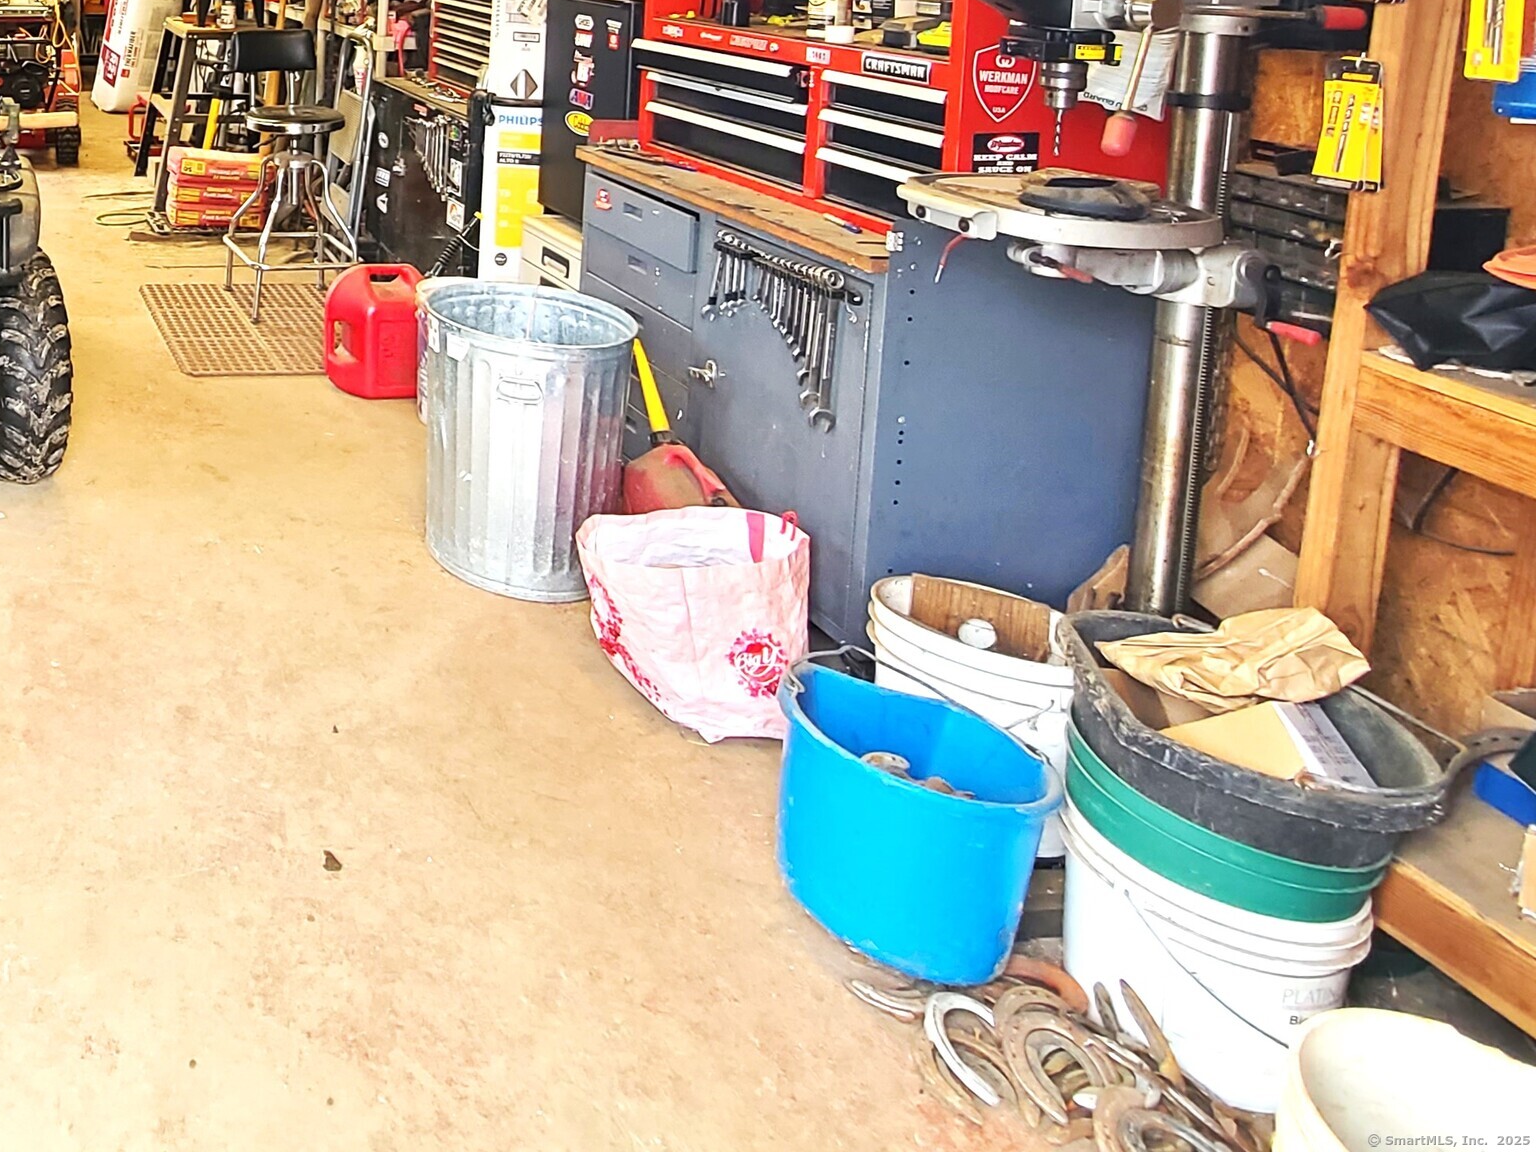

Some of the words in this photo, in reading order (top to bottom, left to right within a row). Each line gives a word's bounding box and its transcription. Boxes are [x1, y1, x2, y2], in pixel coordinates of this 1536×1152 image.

[864, 56, 928, 80] CRAFTSMAN
[978, 69, 1029, 85] WERKMAN
[983, 84, 1020, 95] HOOFCARE
